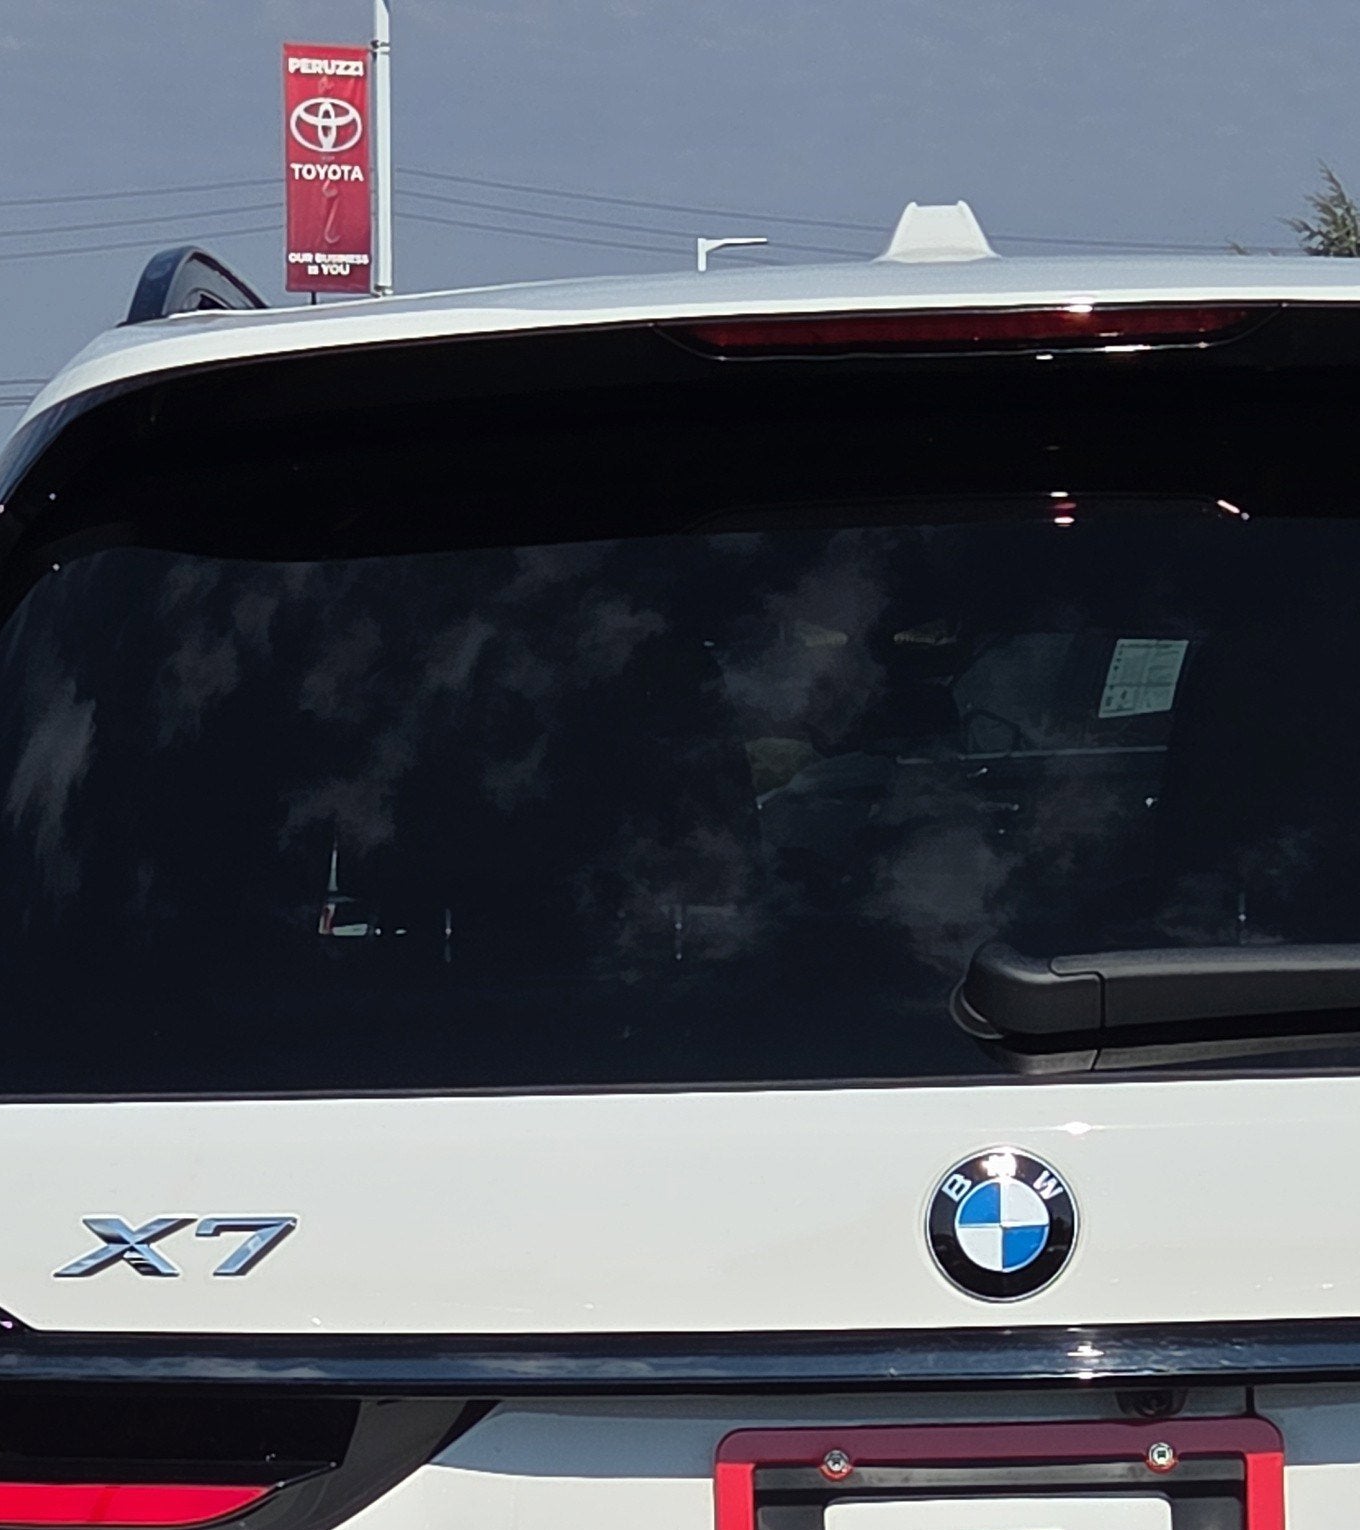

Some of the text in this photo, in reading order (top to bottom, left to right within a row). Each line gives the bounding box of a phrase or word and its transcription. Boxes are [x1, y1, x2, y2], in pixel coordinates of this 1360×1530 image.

[288, 57, 364, 77] PERUZZI
[290, 163, 364, 182] TOYOTA
[321, 263, 350, 276] YOU
[53, 1216, 298, 1277] X7
